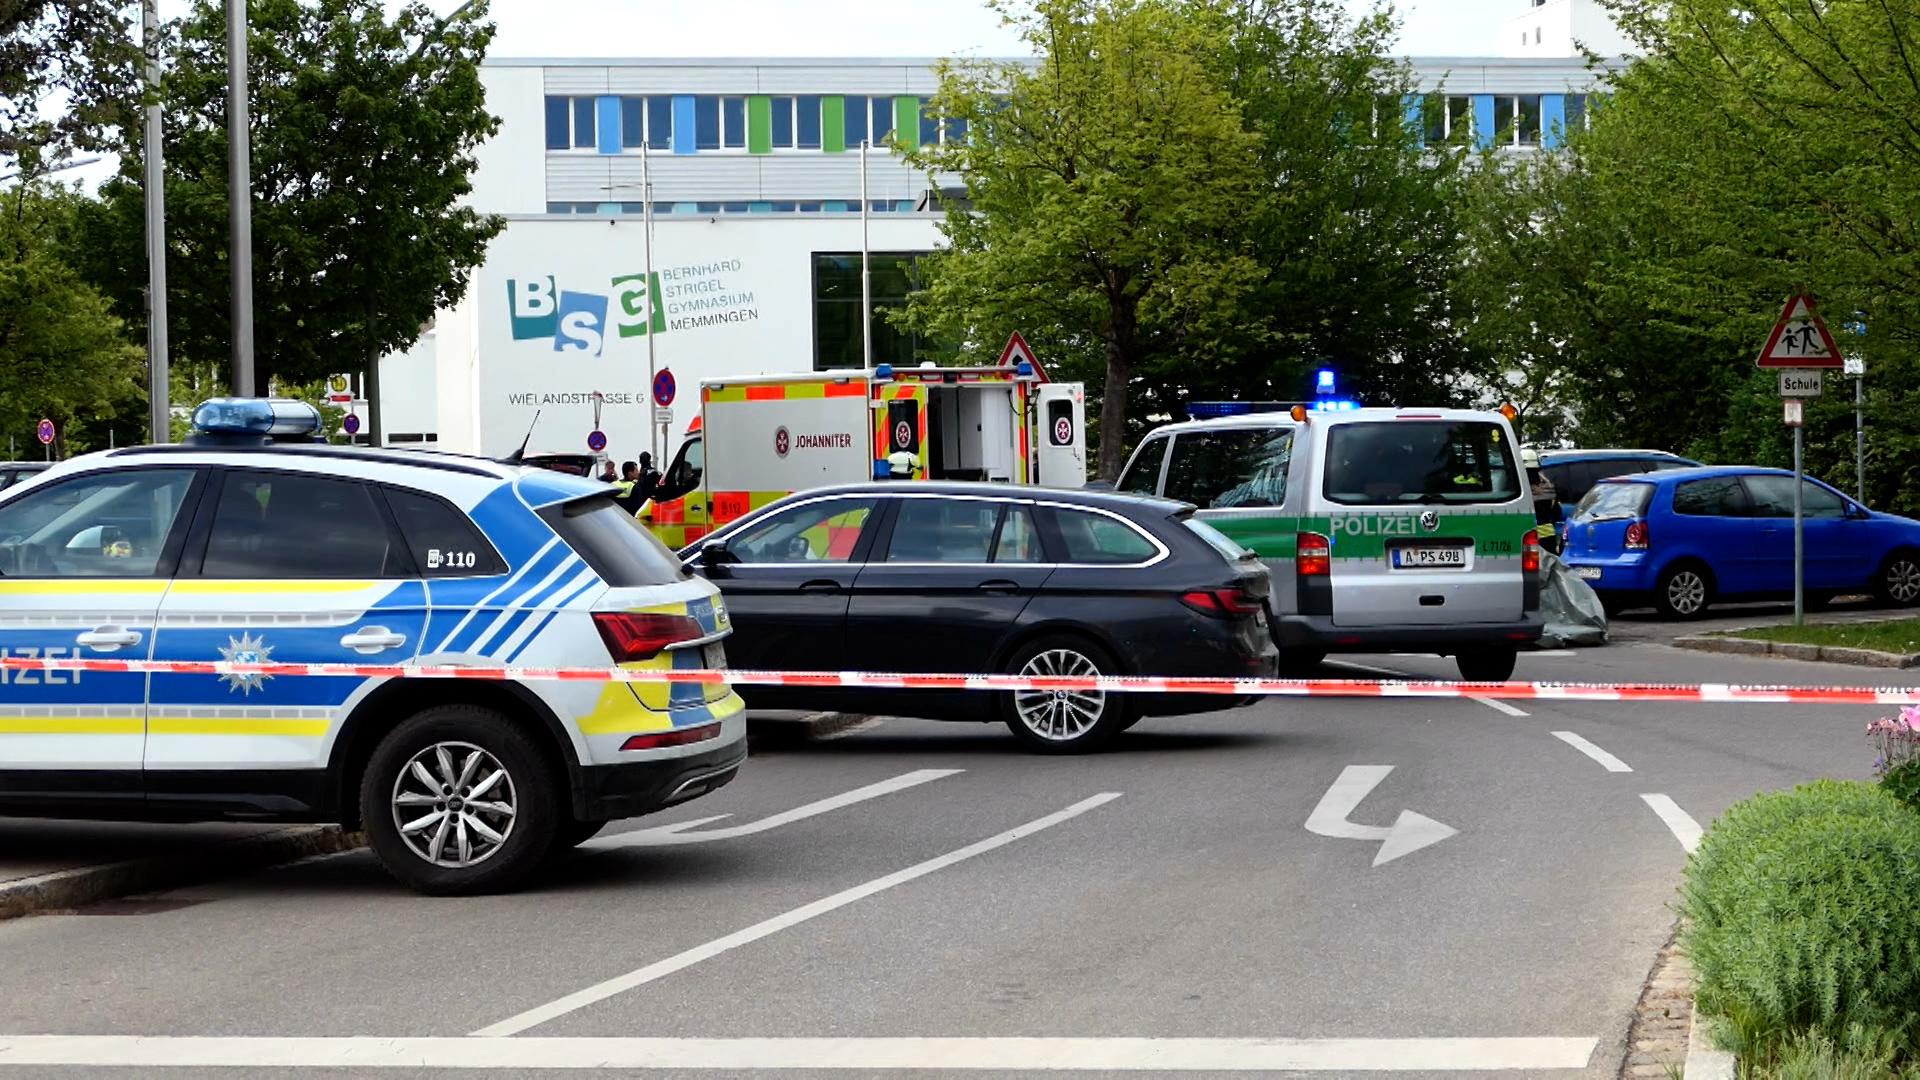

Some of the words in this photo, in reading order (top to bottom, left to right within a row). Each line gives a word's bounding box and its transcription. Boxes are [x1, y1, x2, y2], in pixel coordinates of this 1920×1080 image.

[663, 259, 741, 280] BERNHARD
[665, 279, 726, 298] STRIGEL
[668, 291, 754, 314] GYMNASIUM
[670, 308, 759, 330] MEMMINGEN
[1784, 377, 1819, 390] Schule
[795, 433, 852, 448] JOHANNITER
[1330, 516, 1417, 536] POLIZEI
[446, 551, 476, 568] 110
[1406, 551, 1413, 563] A
[1420, 551, 1436, 562] PS
